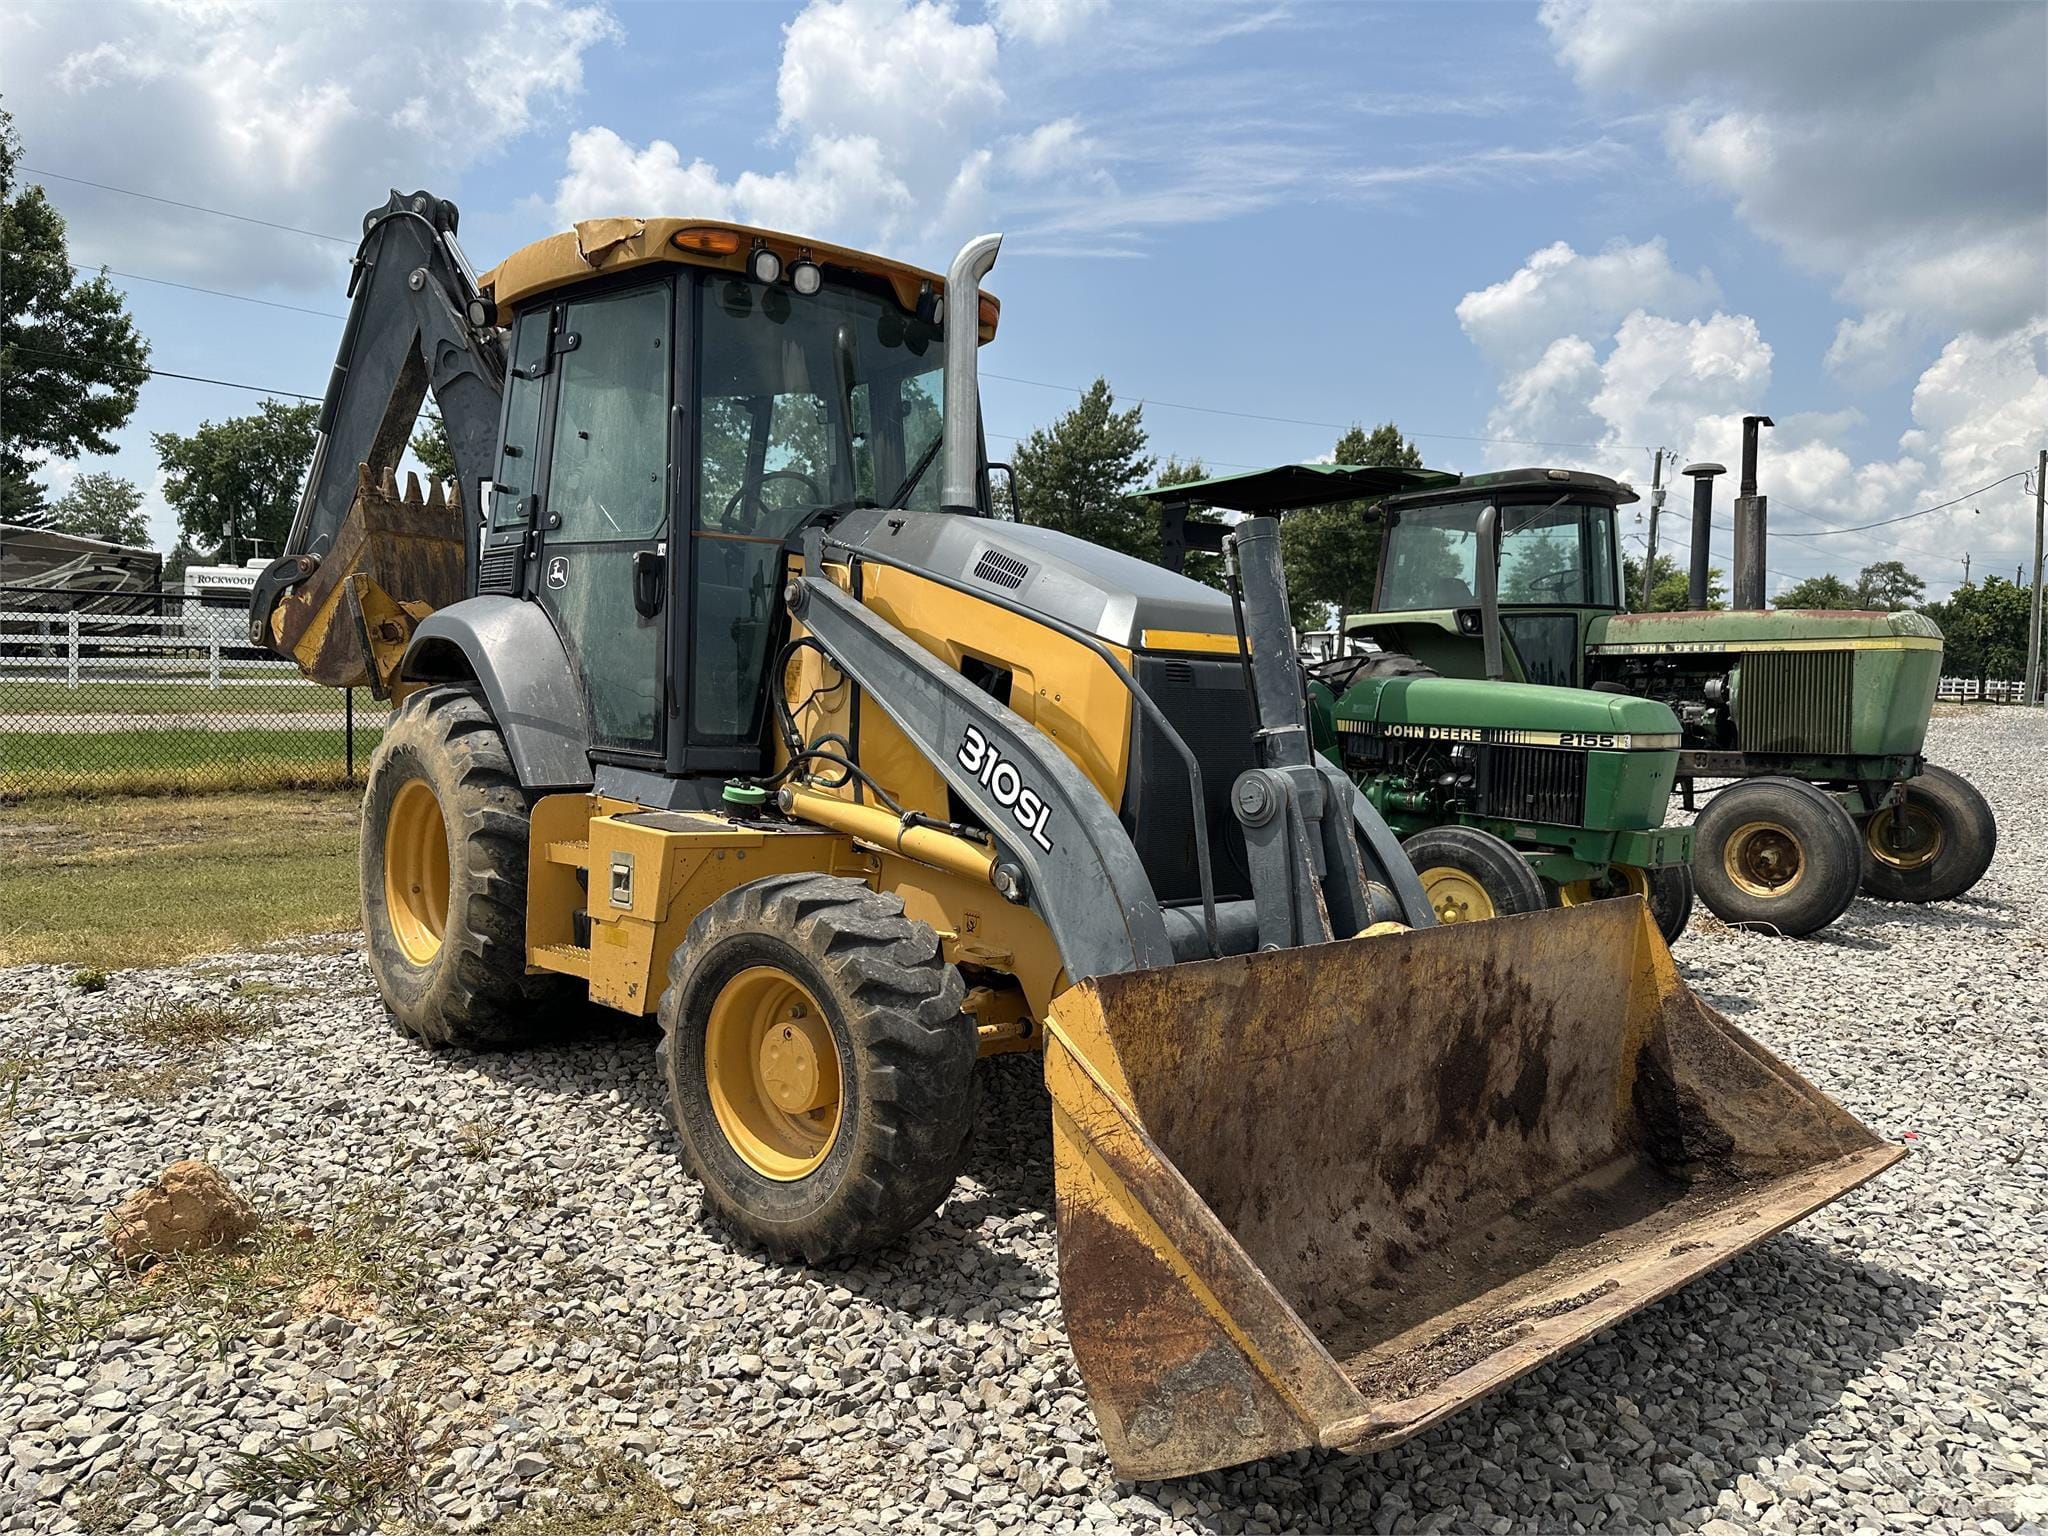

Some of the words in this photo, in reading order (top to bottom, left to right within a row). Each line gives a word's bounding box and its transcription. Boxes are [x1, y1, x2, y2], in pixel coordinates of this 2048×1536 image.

[198, 575, 254, 584] ROCKWOOD
[1632, 645, 1667, 654] JOHN
[1384, 725, 1424, 739] JOHN
[1429, 727, 1482, 741] DEERE
[1560, 733, 1615, 748] 2155
[957, 723, 1054, 855] 310SL
